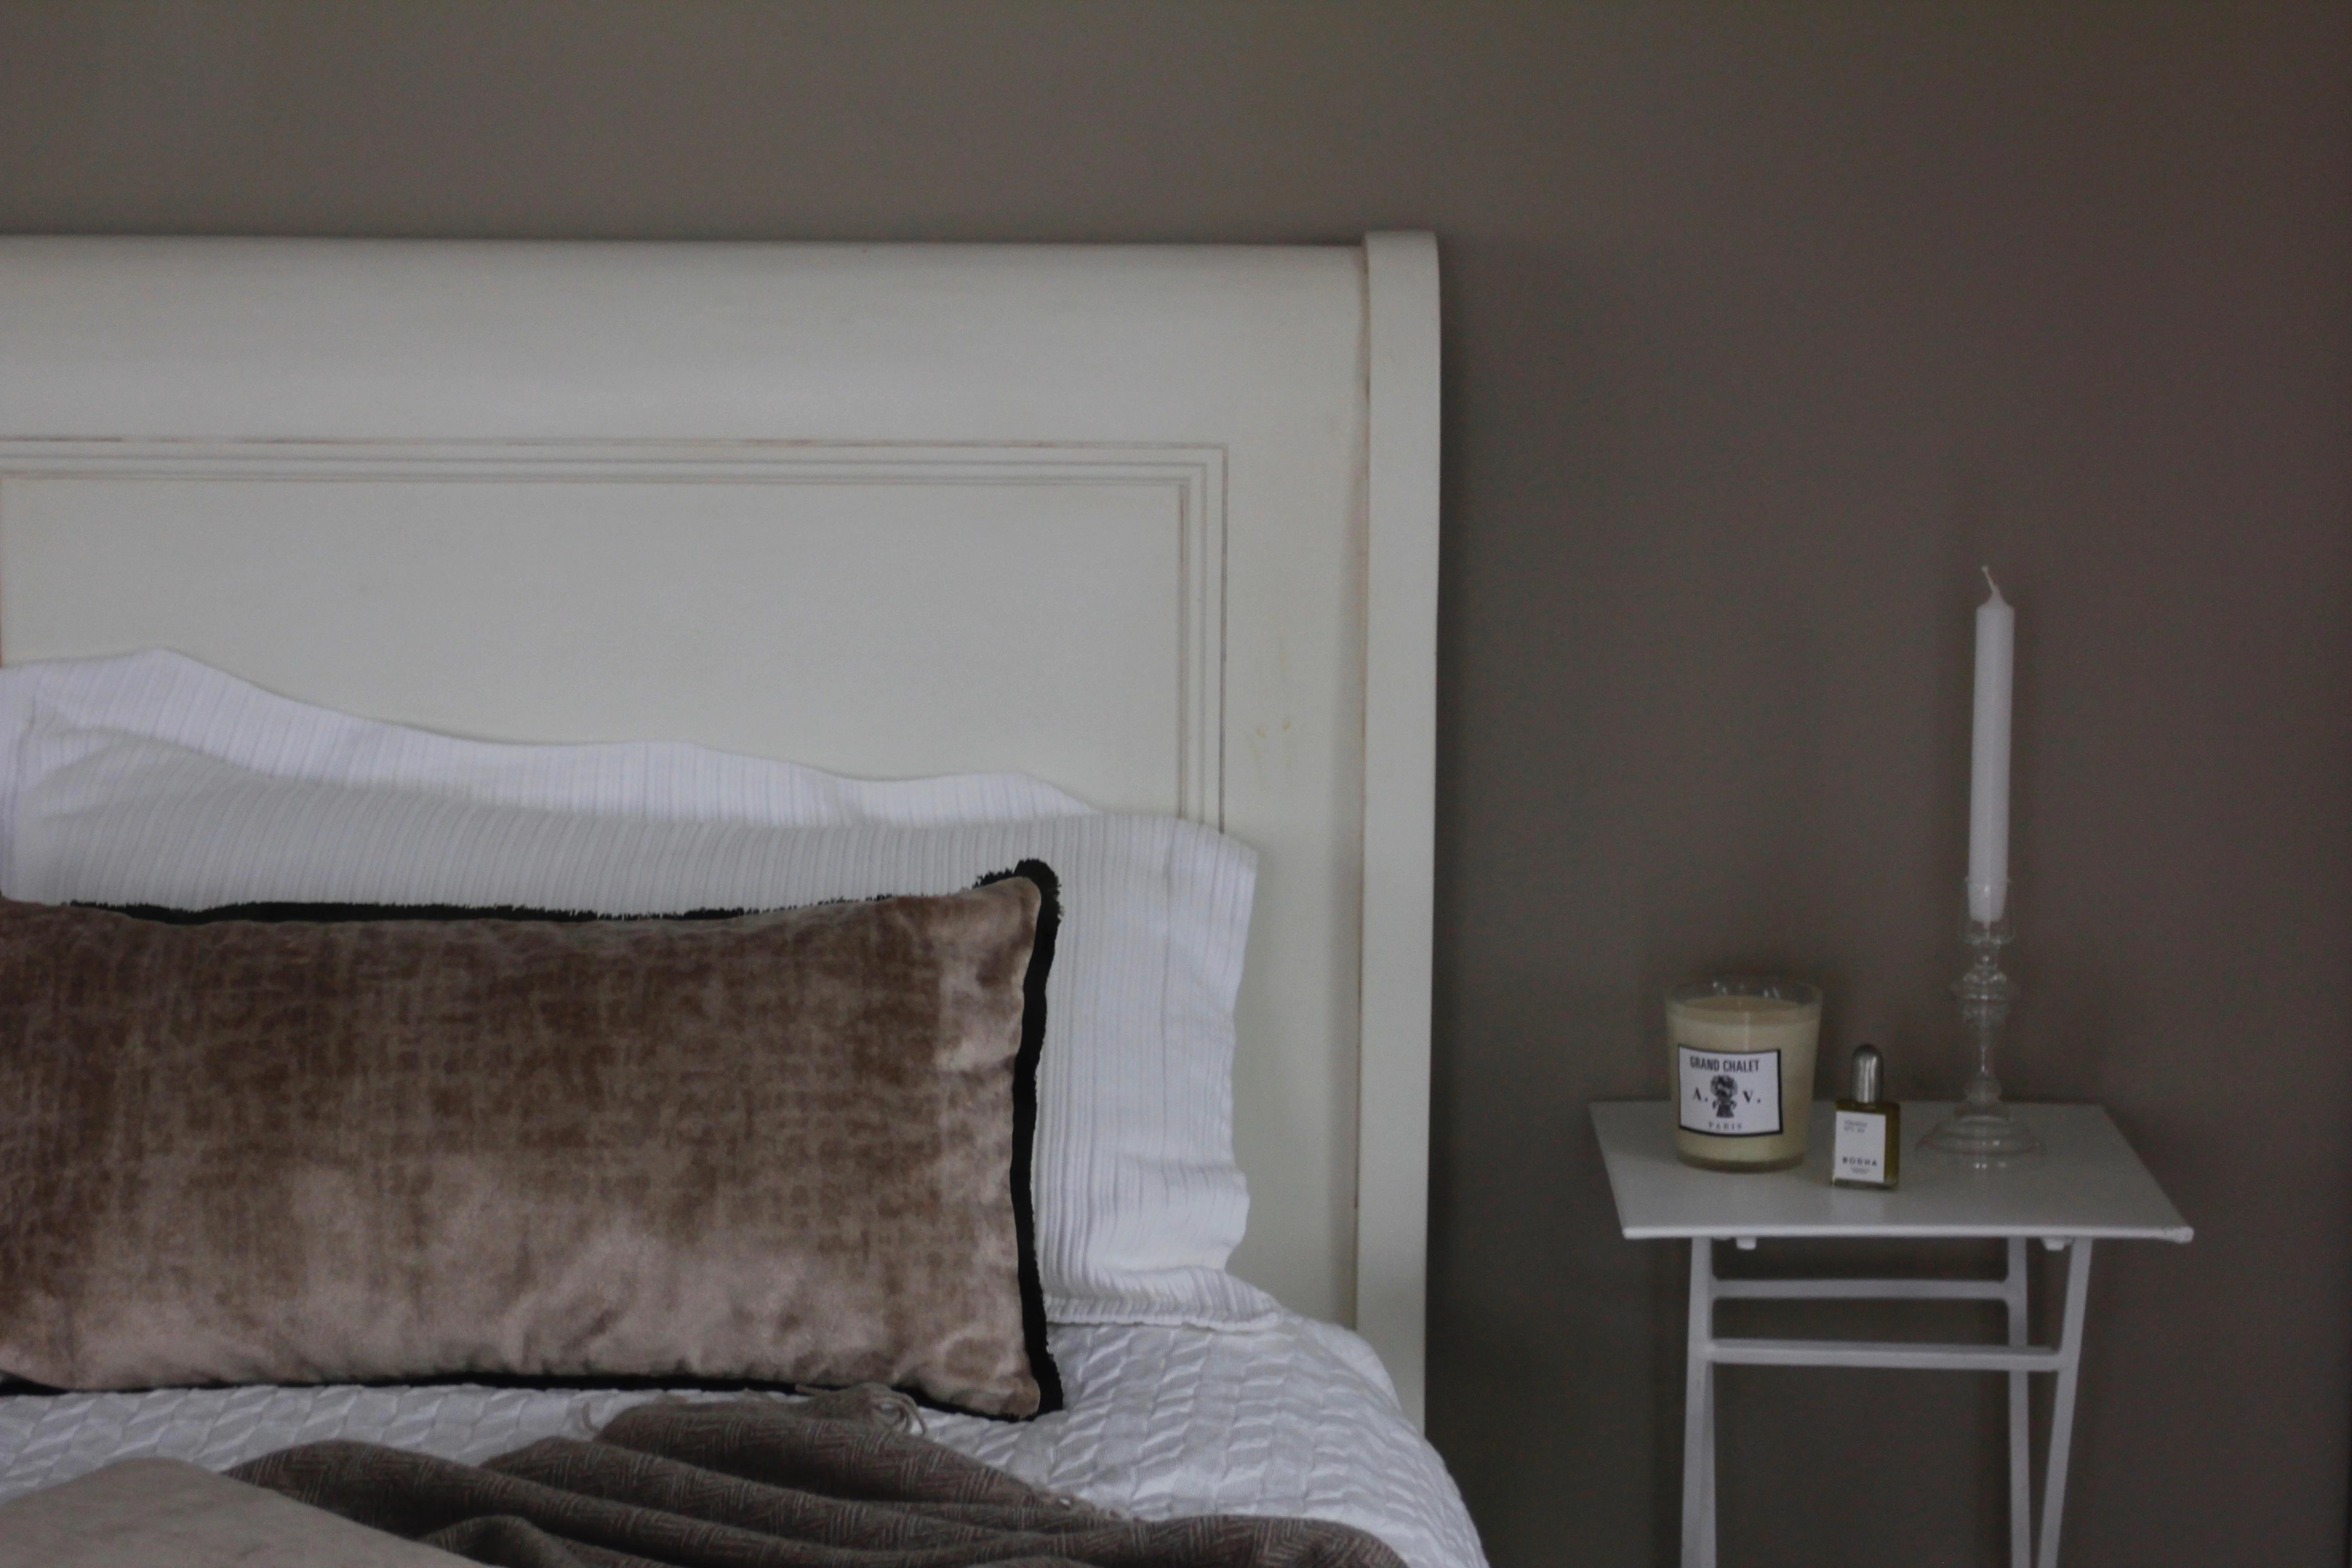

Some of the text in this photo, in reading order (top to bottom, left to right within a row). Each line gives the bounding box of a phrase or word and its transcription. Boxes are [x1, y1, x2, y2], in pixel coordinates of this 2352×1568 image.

[1690, 1056, 1760, 1073] GRAND CHALET
[1708, 1121, 1743, 1130] PARIS
